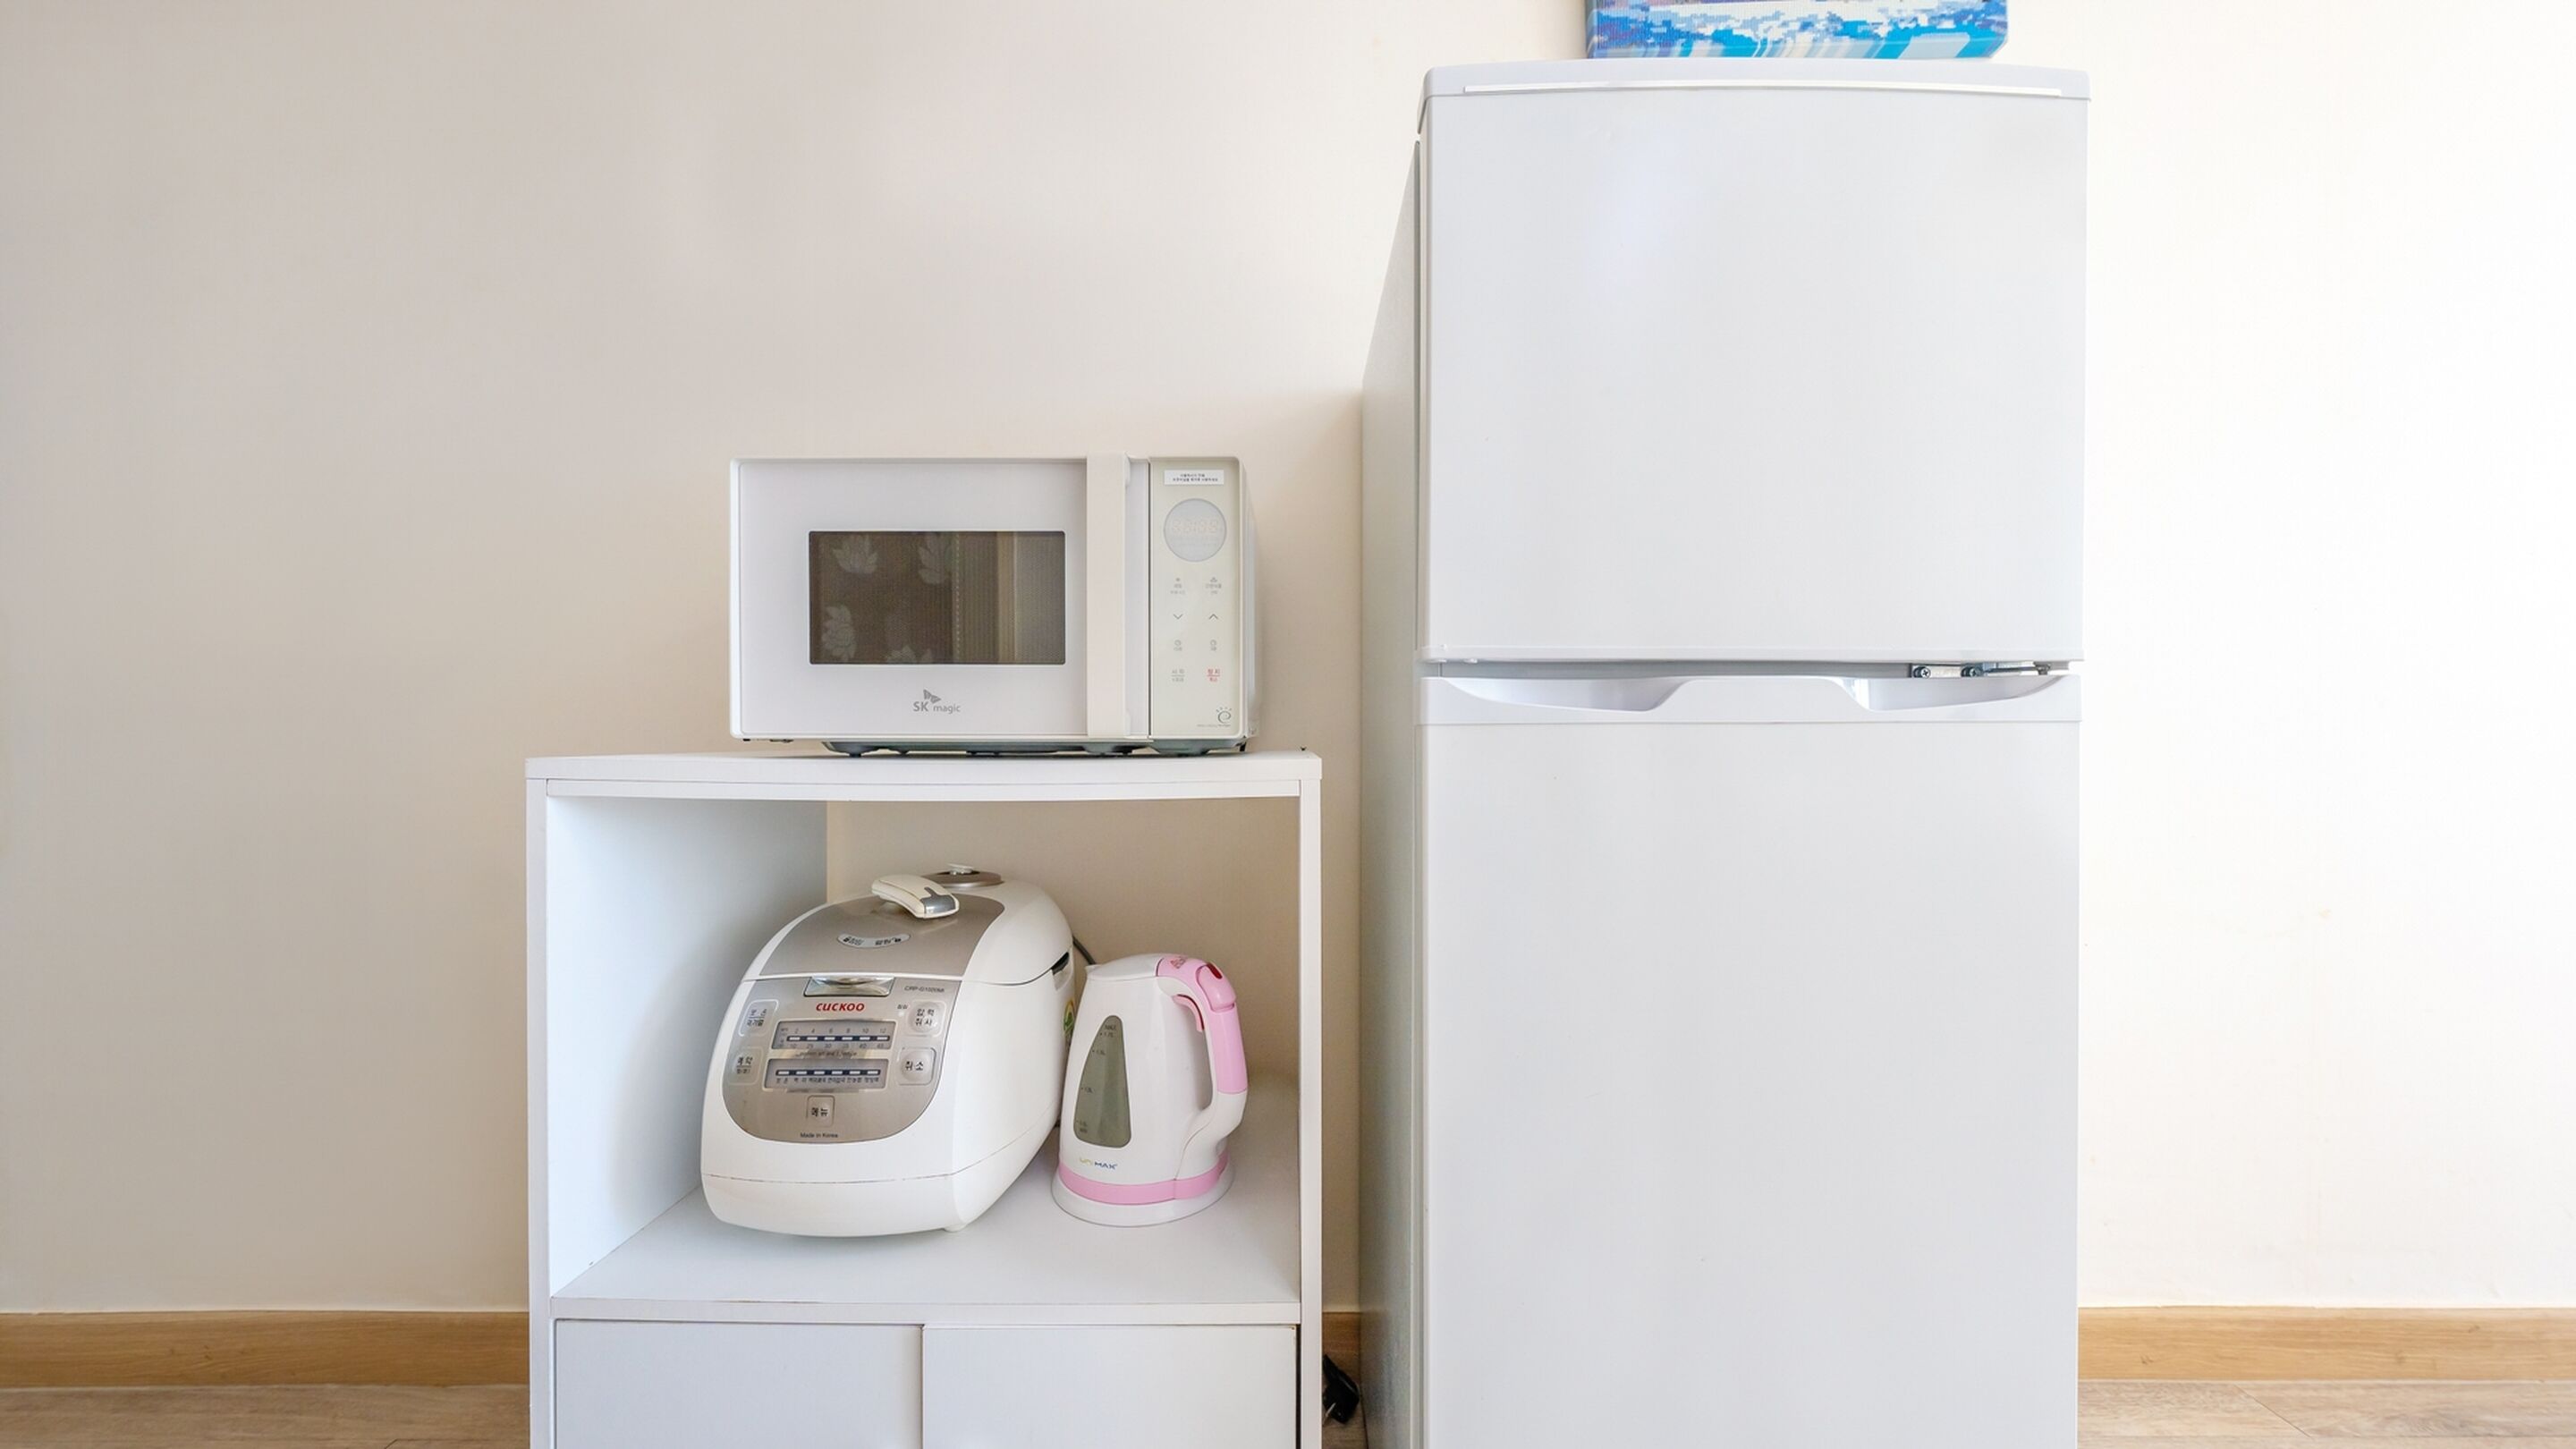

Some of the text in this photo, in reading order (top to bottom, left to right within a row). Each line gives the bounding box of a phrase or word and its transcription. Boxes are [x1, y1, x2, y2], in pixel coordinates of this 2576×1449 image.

[913, 701, 961, 714] SK magic
[816, 1003, 865, 1012] CUCKOO
[915, 1018, 932, 1026] 취사
[905, 1061, 923, 1071] 취소
[811, 1107, 828, 1116] 메뉴
